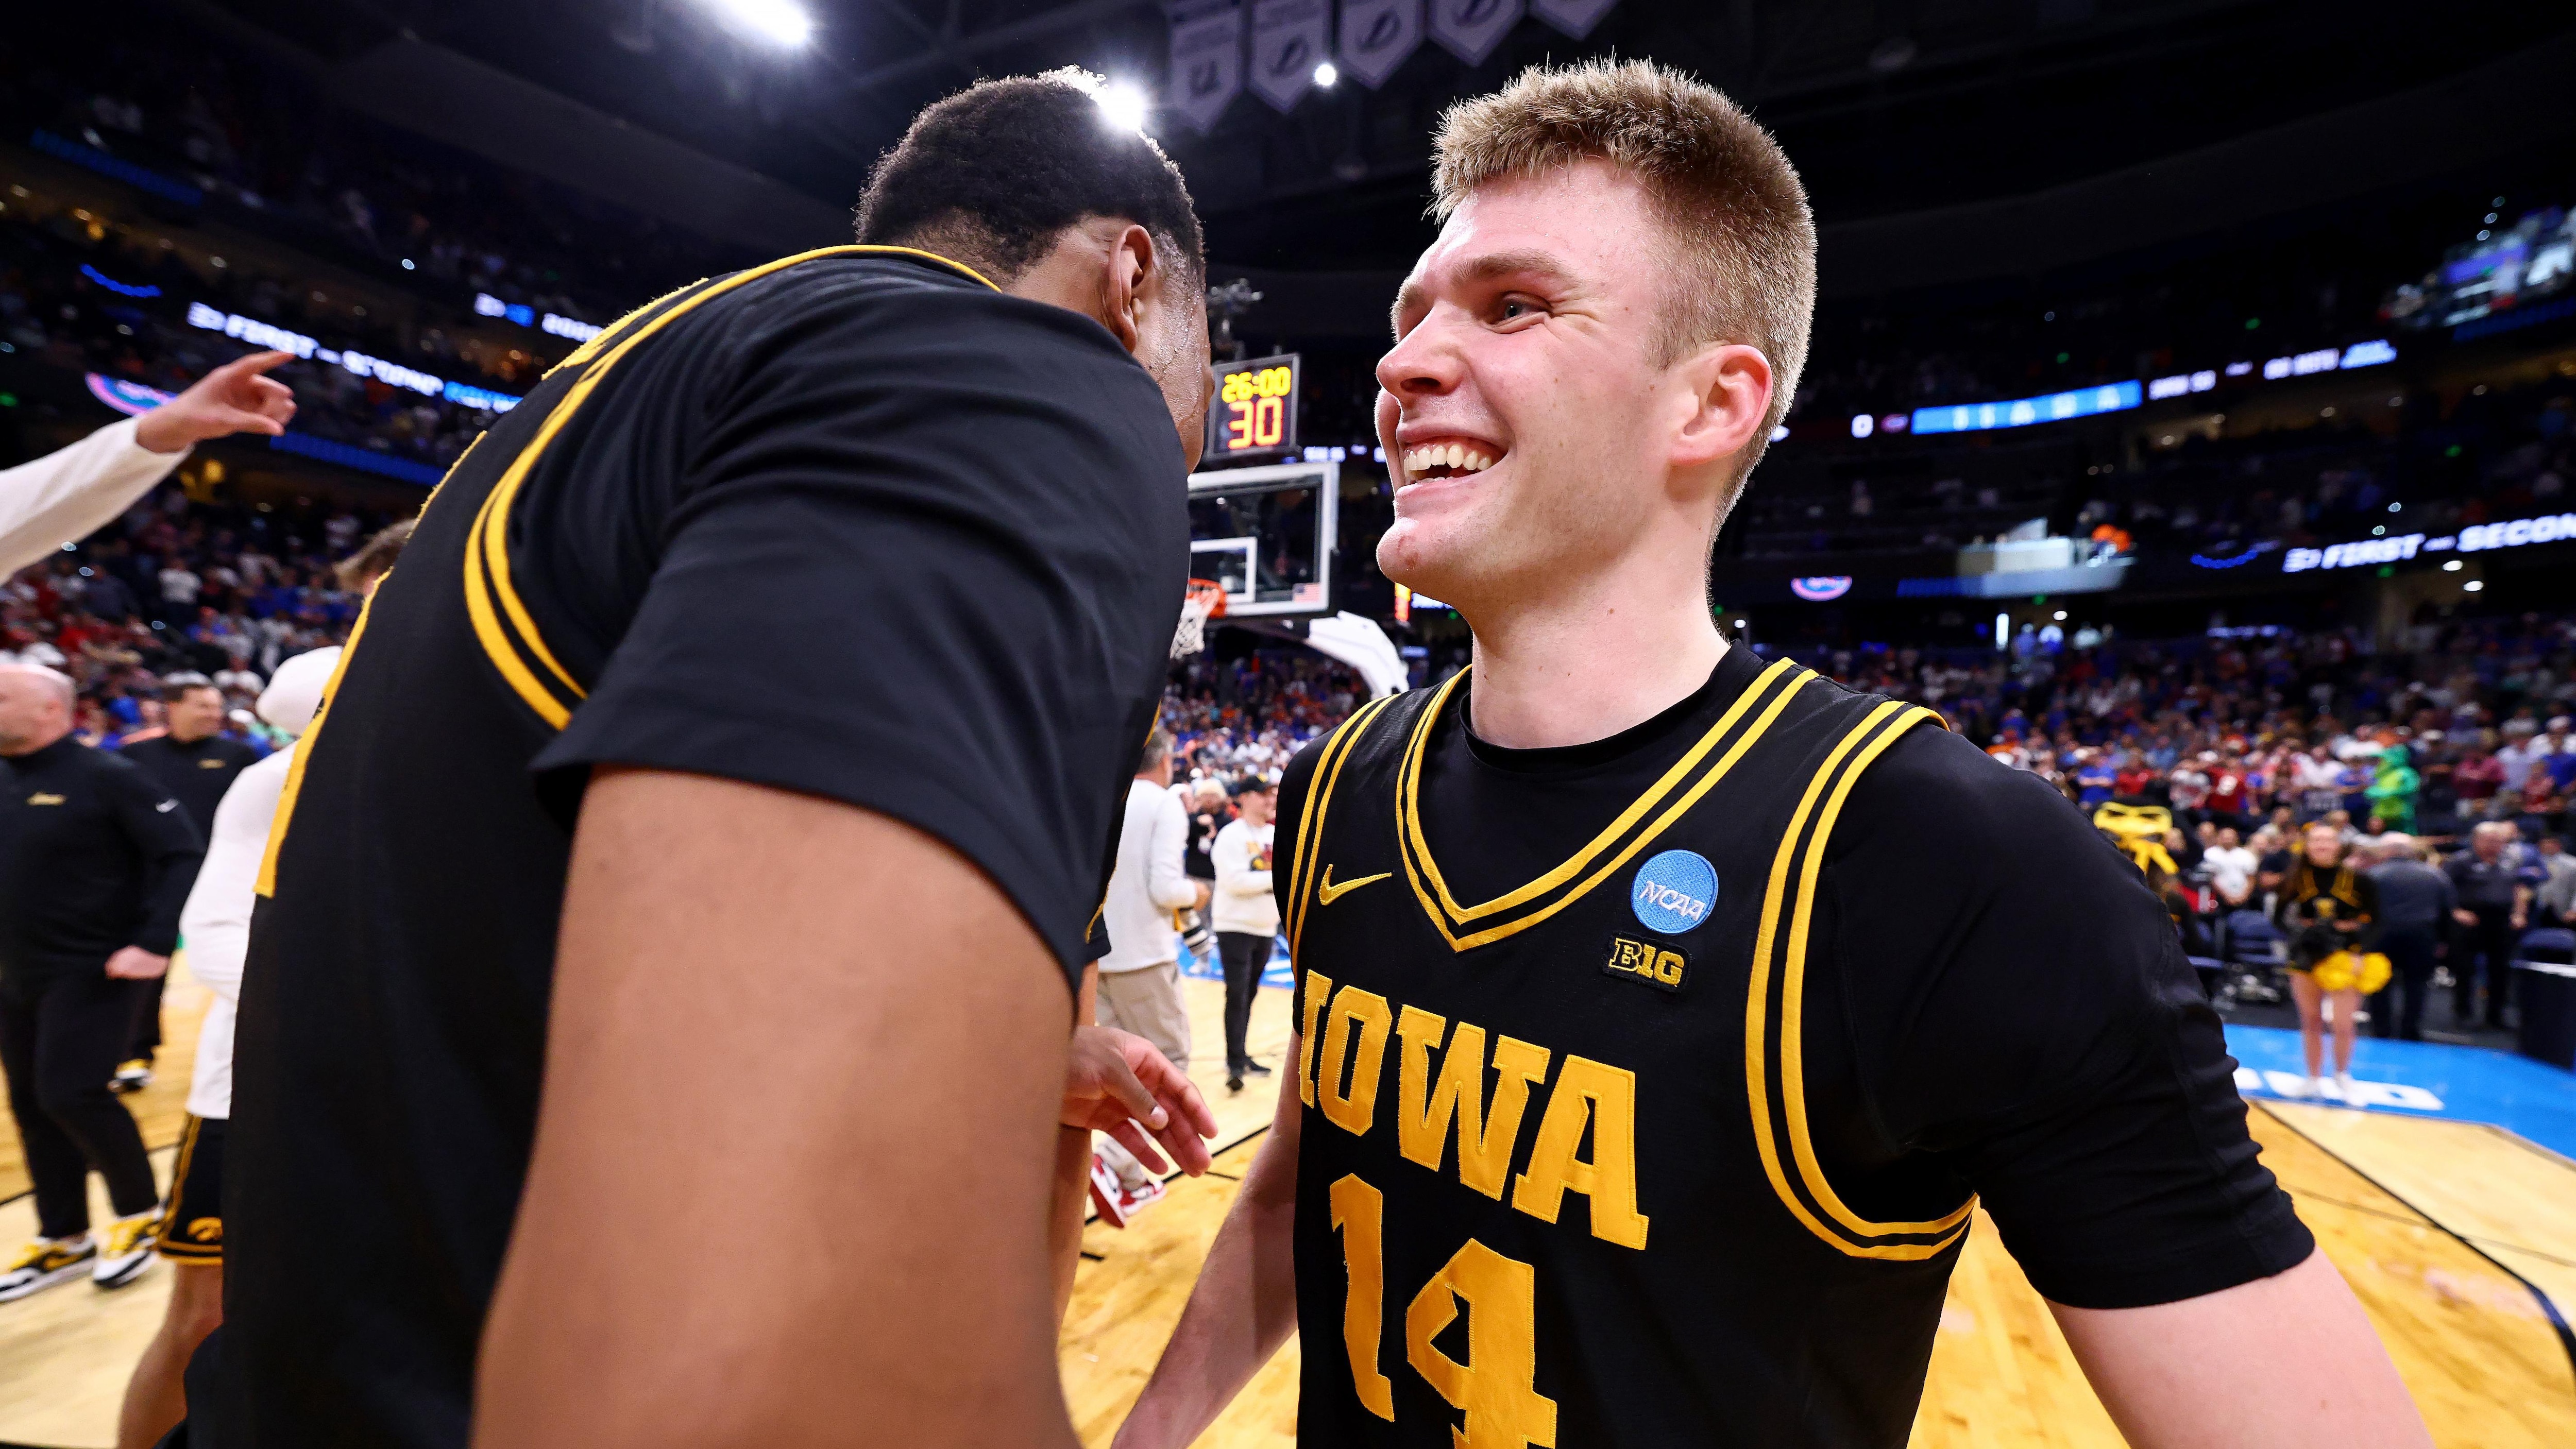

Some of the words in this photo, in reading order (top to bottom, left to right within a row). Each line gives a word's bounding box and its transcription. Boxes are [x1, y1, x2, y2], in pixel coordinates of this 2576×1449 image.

[1222, 366, 1292, 403] 26:00
[1228, 396, 1284, 450] 30
[2320, 533, 2426, 570] FIRST
[1638, 880, 1706, 922] NCAA
[1299, 969, 1649, 1251] IOWA
[1329, 1172, 1557, 1449] 14
